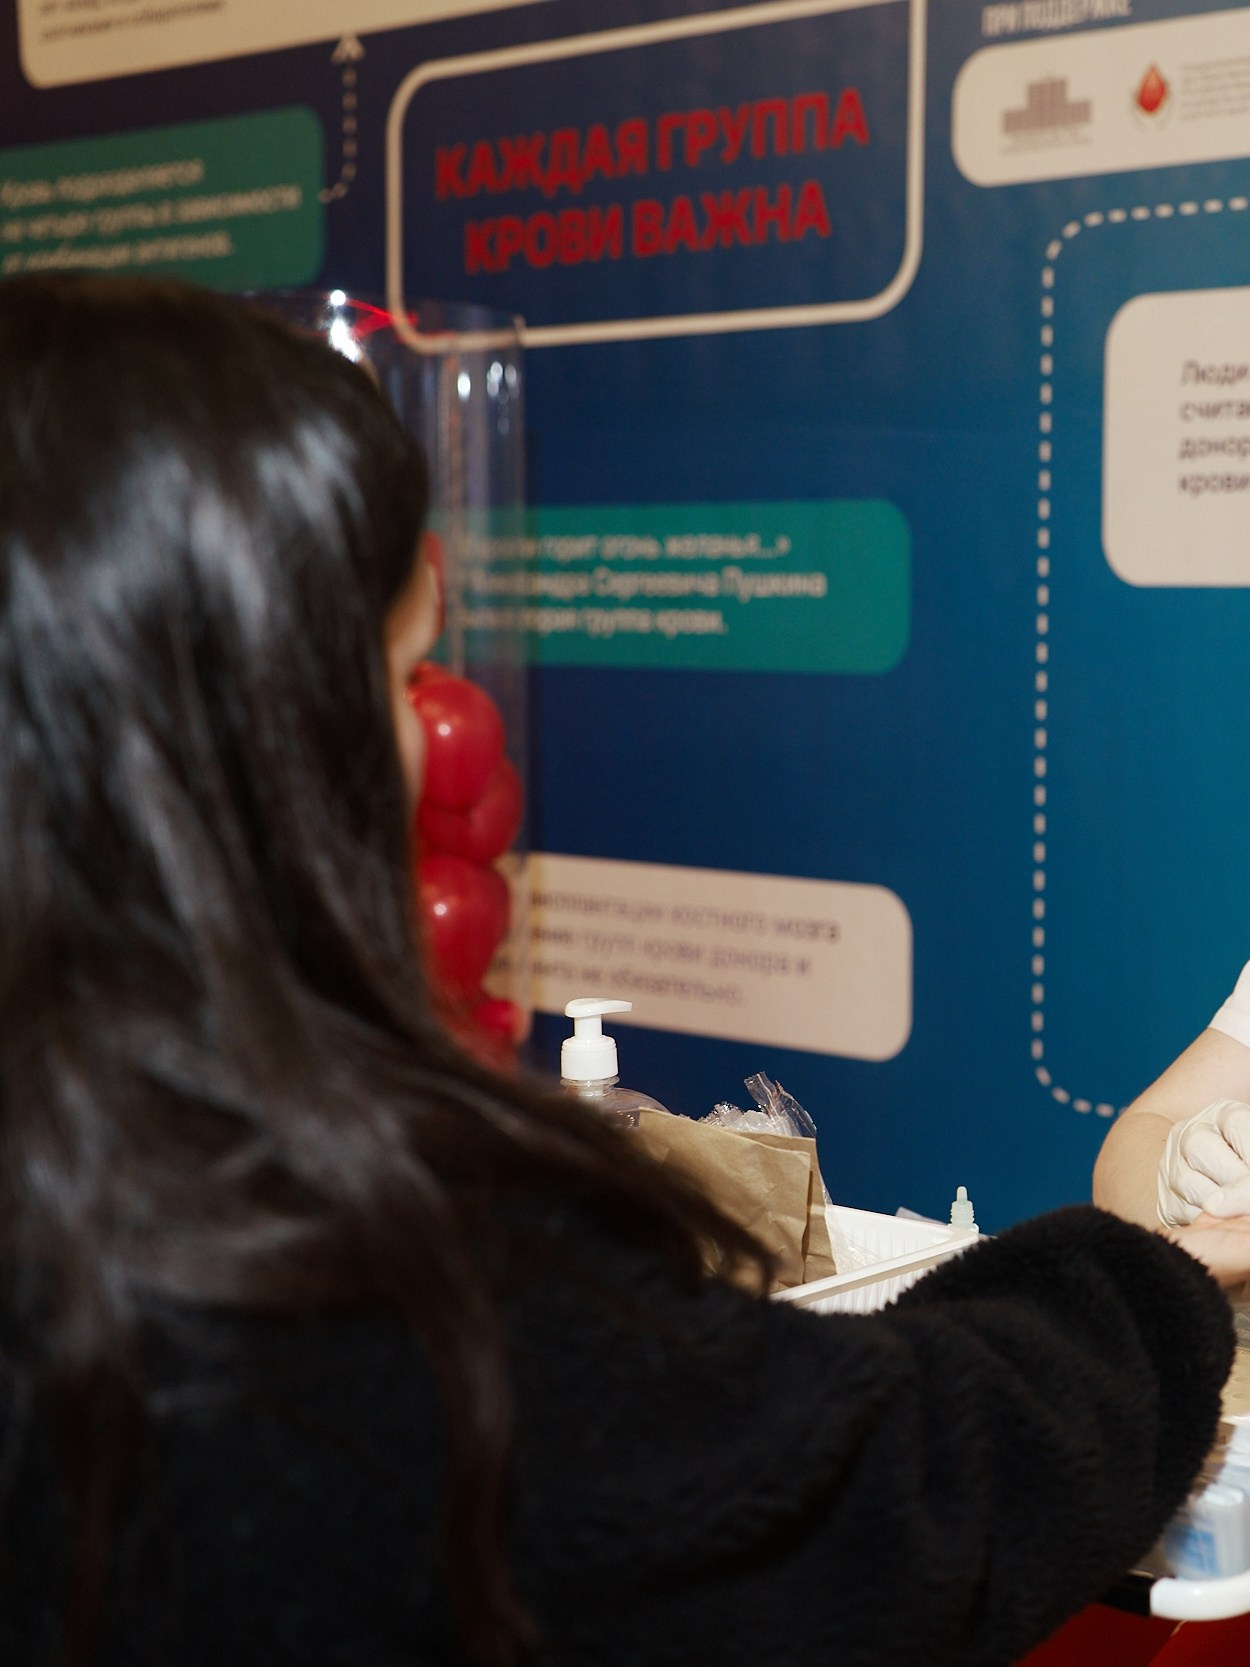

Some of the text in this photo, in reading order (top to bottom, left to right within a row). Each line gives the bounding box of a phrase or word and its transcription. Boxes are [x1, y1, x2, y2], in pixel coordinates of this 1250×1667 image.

[435, 87, 871, 199] КАЖДАЯ ГРУППА
[464, 179, 832, 275] КРОВИ ВАЖНА
[1181, 359, 1249, 387] Люди
[1179, 471, 1250, 498] крови
